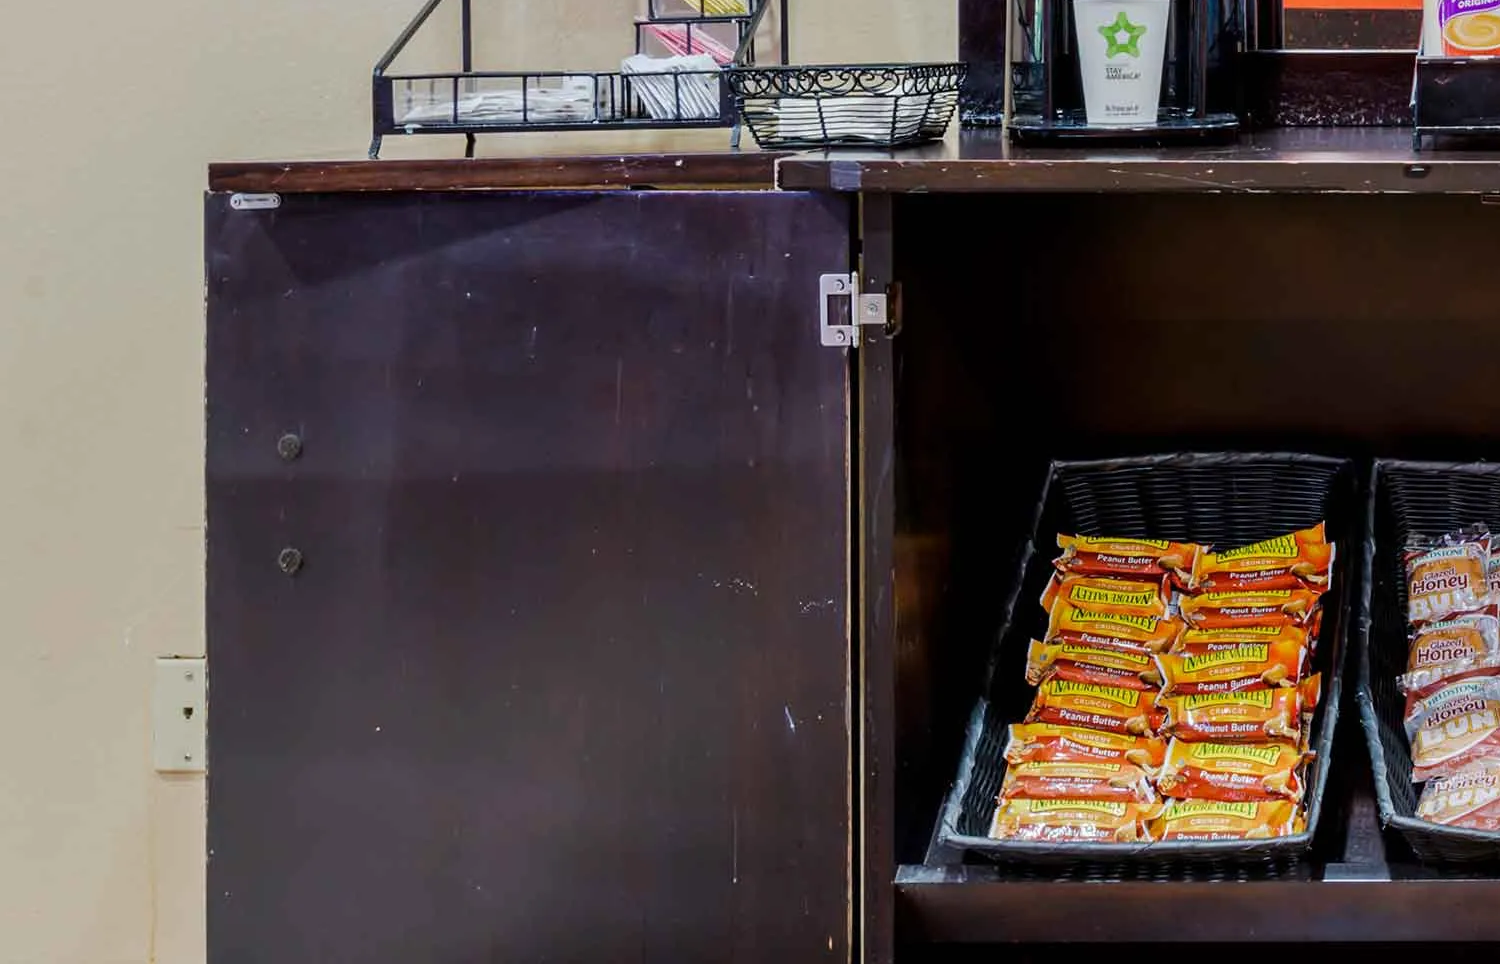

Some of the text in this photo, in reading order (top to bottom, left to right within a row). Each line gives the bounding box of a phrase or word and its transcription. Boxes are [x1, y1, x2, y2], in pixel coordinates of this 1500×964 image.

[1096, 554, 1153, 565] Peanut Butter
[1260, 569, 1285, 577] Butter
[1412, 574, 1468, 595] Honey
[1250, 606, 1277, 614] Butter
[1079, 633, 1110, 645] Peanut
[1430, 639, 1462, 649] Glazed
[1186, 644, 1265, 670] NATURE VALLEY
[1197, 681, 1228, 691] Peanut
[1054, 680, 1136, 705] NATURE VALLEY
[1072, 697, 1112, 709] CRUNCHY
[1059, 709, 1121, 726] Peanut Butter
[1427, 699, 1486, 727] Honey
[1199, 723, 1259, 733] Peanut Butter
[1092, 745, 1120, 757] Butter
[1198, 743, 1238, 757] NATURE
[1200, 770, 1258, 784] Peanut Butter
